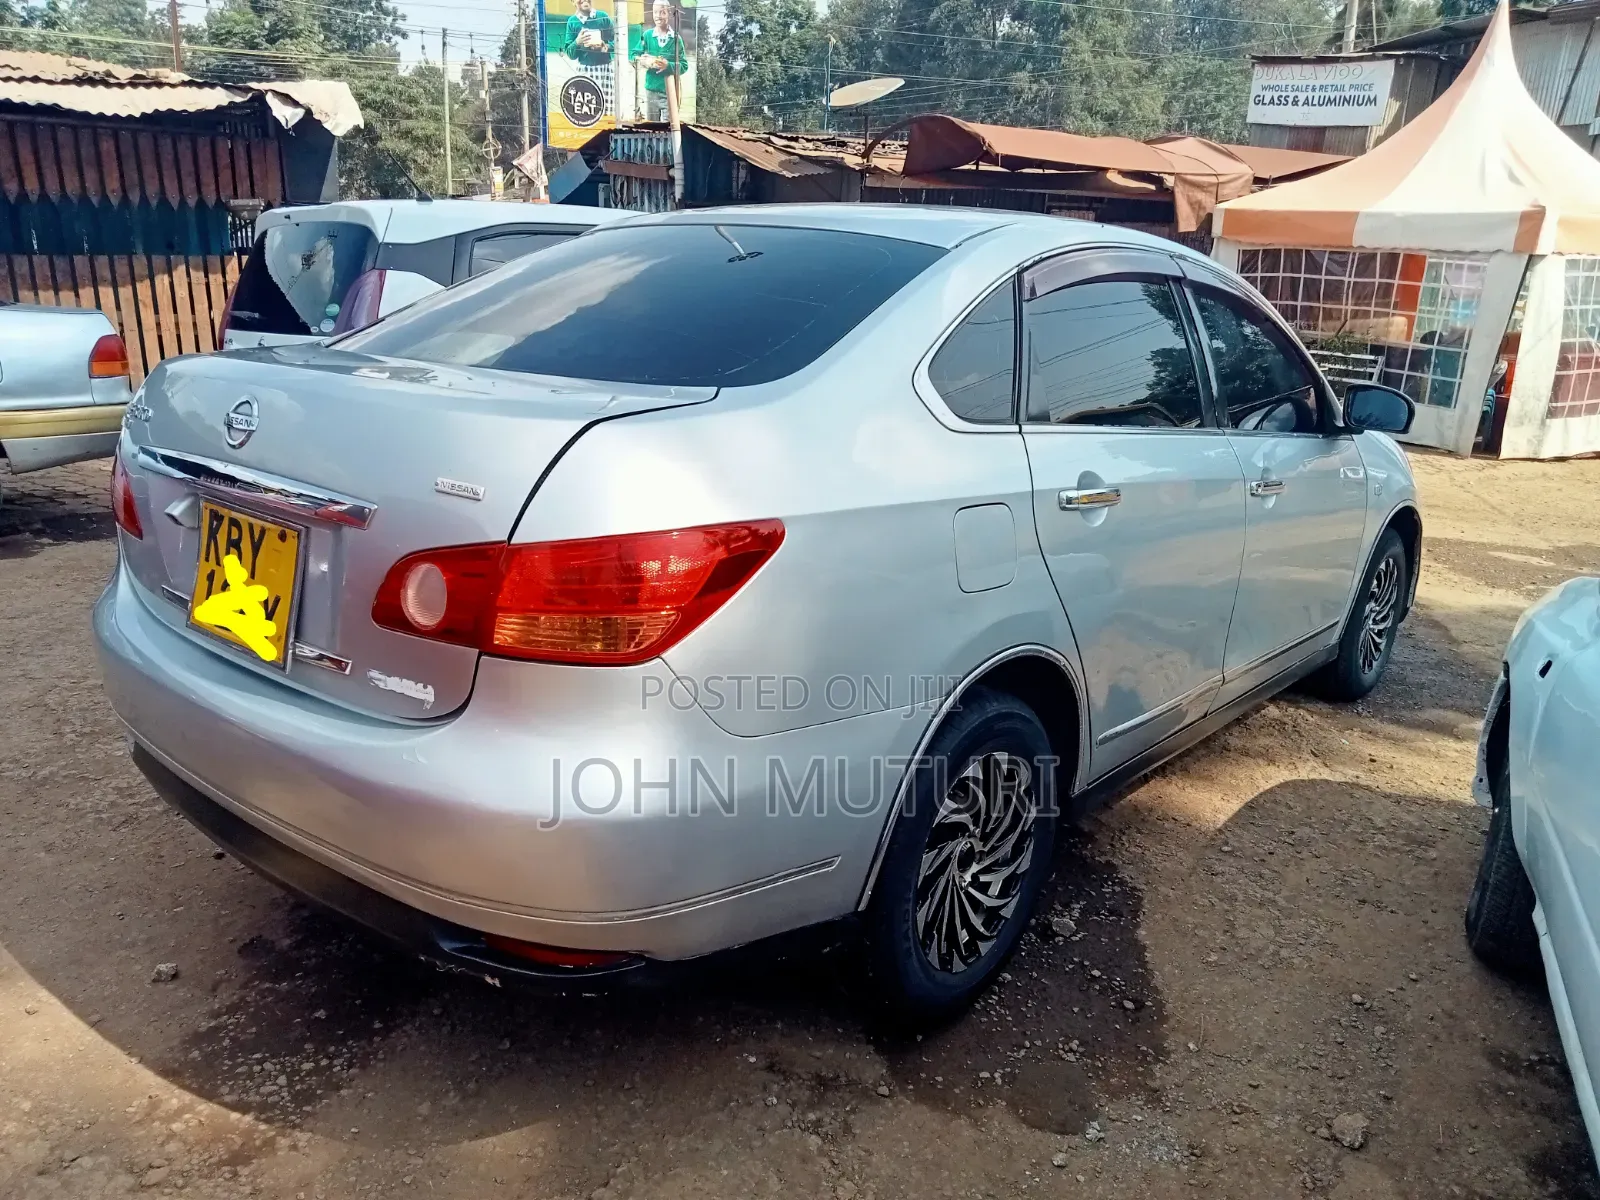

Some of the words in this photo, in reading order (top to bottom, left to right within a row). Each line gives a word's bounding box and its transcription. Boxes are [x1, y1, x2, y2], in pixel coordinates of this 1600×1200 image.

[1318, 84, 1346, 93] RETAIL
[1348, 82, 1375, 92] PRICE
[1253, 94, 1290, 106] GLASS
[1291, 95, 1300, 107] &
[1301, 94, 1378, 107] ALUMINIUM
[574, 102, 597, 115] EAT
[440, 481, 479, 496] NISSAN
[204, 508, 267, 581] KBY
